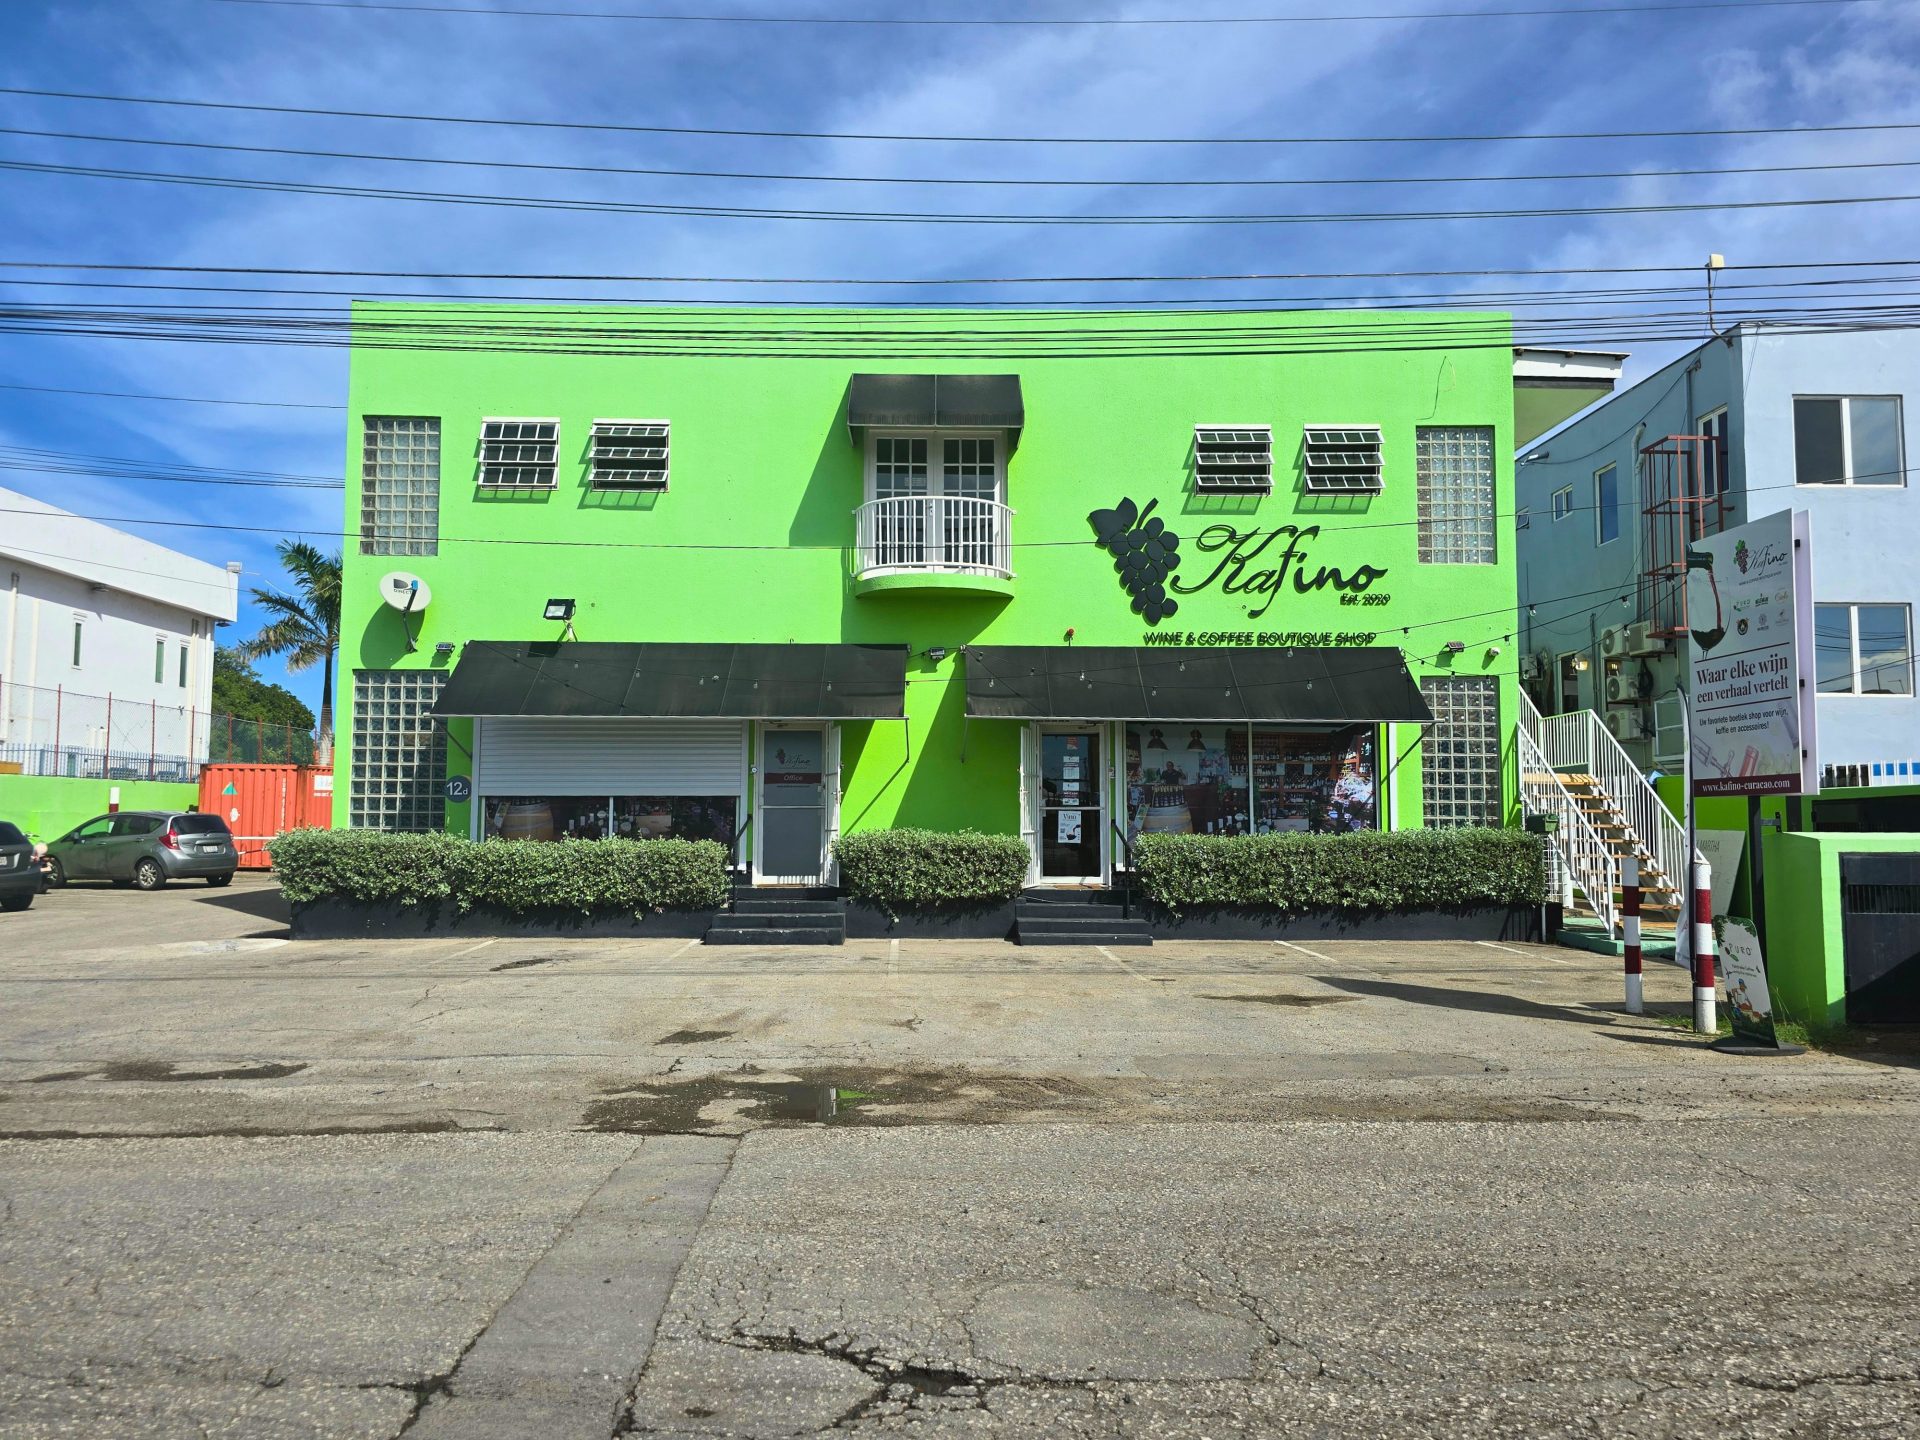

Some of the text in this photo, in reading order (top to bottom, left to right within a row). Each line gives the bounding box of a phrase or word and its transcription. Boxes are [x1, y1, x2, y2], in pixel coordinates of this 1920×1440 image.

[1170, 524, 1389, 619] Kafino
[1361, 593, 1391, 606] 2020
[1143, 631, 1378, 646] WINE & COFFEE BOUTIQUE SHOP
[1696, 653, 1789, 686] Waar elke wijn
[1697, 675, 1789, 703] een verhaal vertelt
[1707, 715, 1729, 725] favoriete
[1748, 710, 1762, 720] shop
[1762, 710, 1774, 718] voor
[1737, 721, 1770, 733] accessoires!
[1702, 779, 1791, 792] www.kafino-curacao.com
[1729, 943, 1752, 956] PURO
